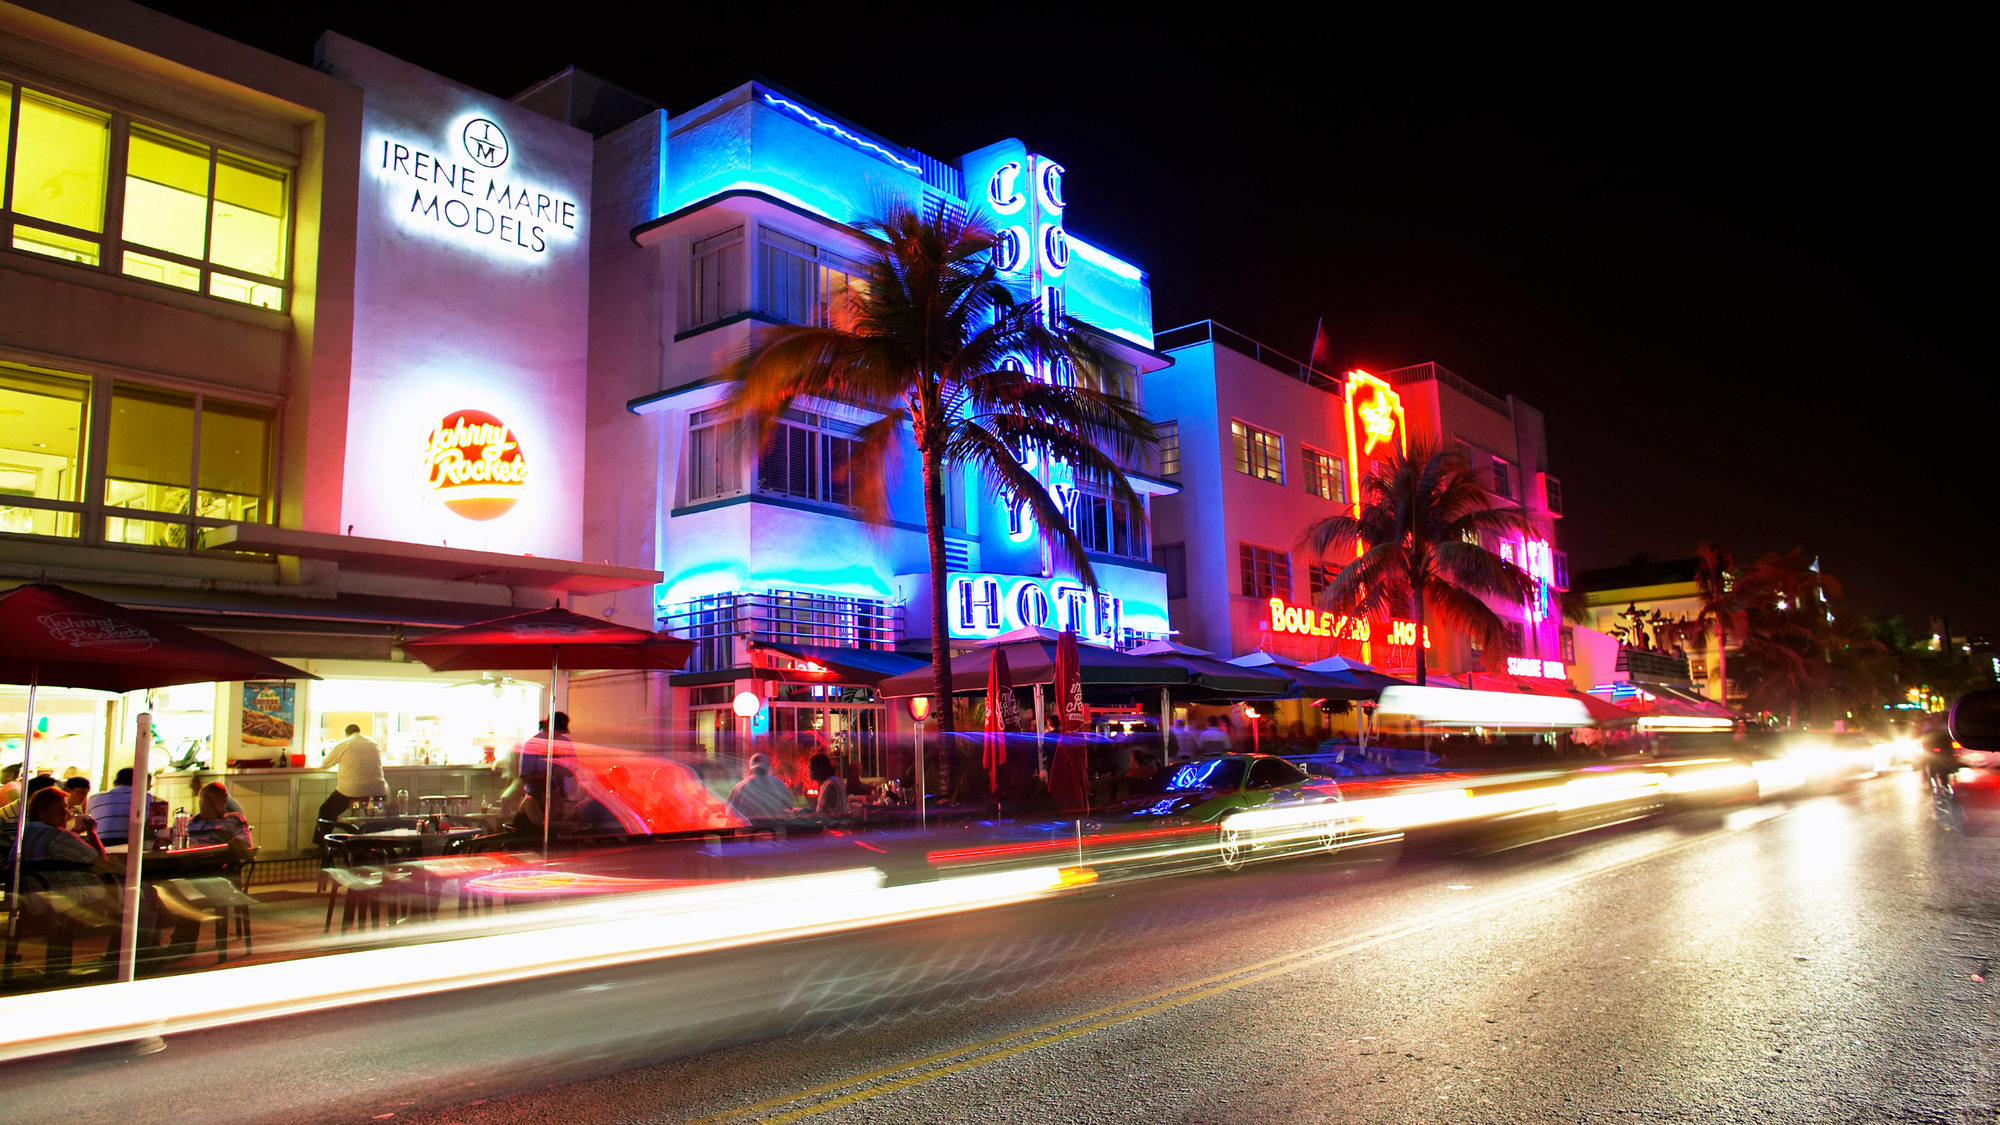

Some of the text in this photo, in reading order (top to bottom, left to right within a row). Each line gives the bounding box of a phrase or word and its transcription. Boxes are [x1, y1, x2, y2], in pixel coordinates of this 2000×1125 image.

[476, 141, 495, 163] M
[383, 140, 576, 230] IRENE MARIE
[410, 188, 546, 253] MODELS
[37, 615, 125, 640] Johnny
[251, 698, 280, 706] CHEESE
